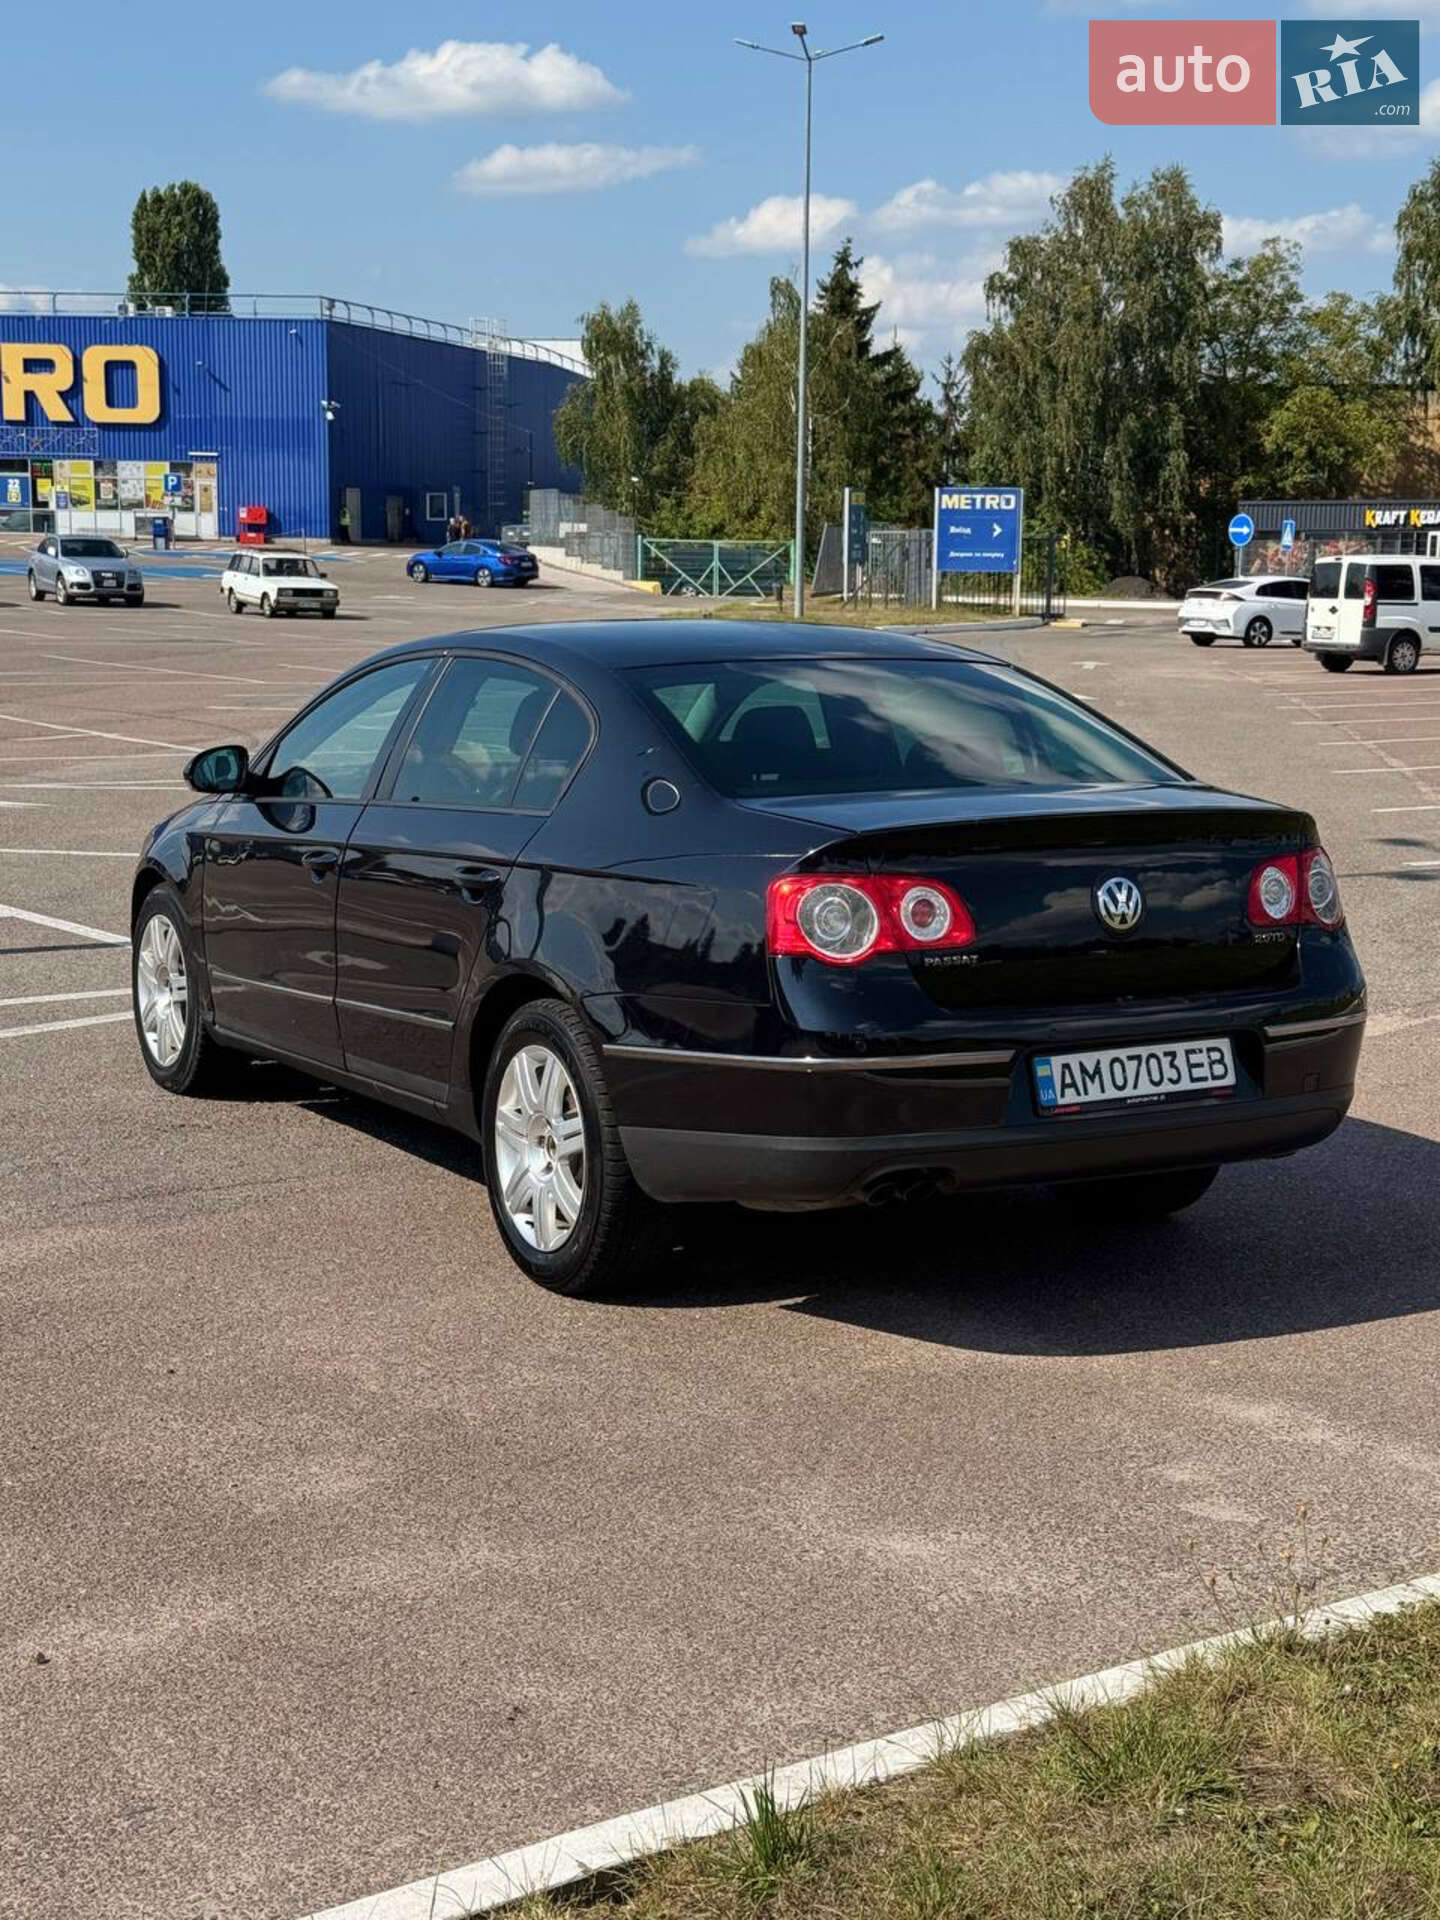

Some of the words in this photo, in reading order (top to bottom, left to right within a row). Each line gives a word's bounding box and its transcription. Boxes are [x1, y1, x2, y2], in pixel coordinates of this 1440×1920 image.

[0, 343, 161, 424] RO
[167, 475, 178, 491] P
[941, 494, 1016, 510] METRO
[1365, 509, 1407, 528] KRAFT
[924, 955, 979, 967] PASSAT
[1040, 1088, 1056, 1101] UA
